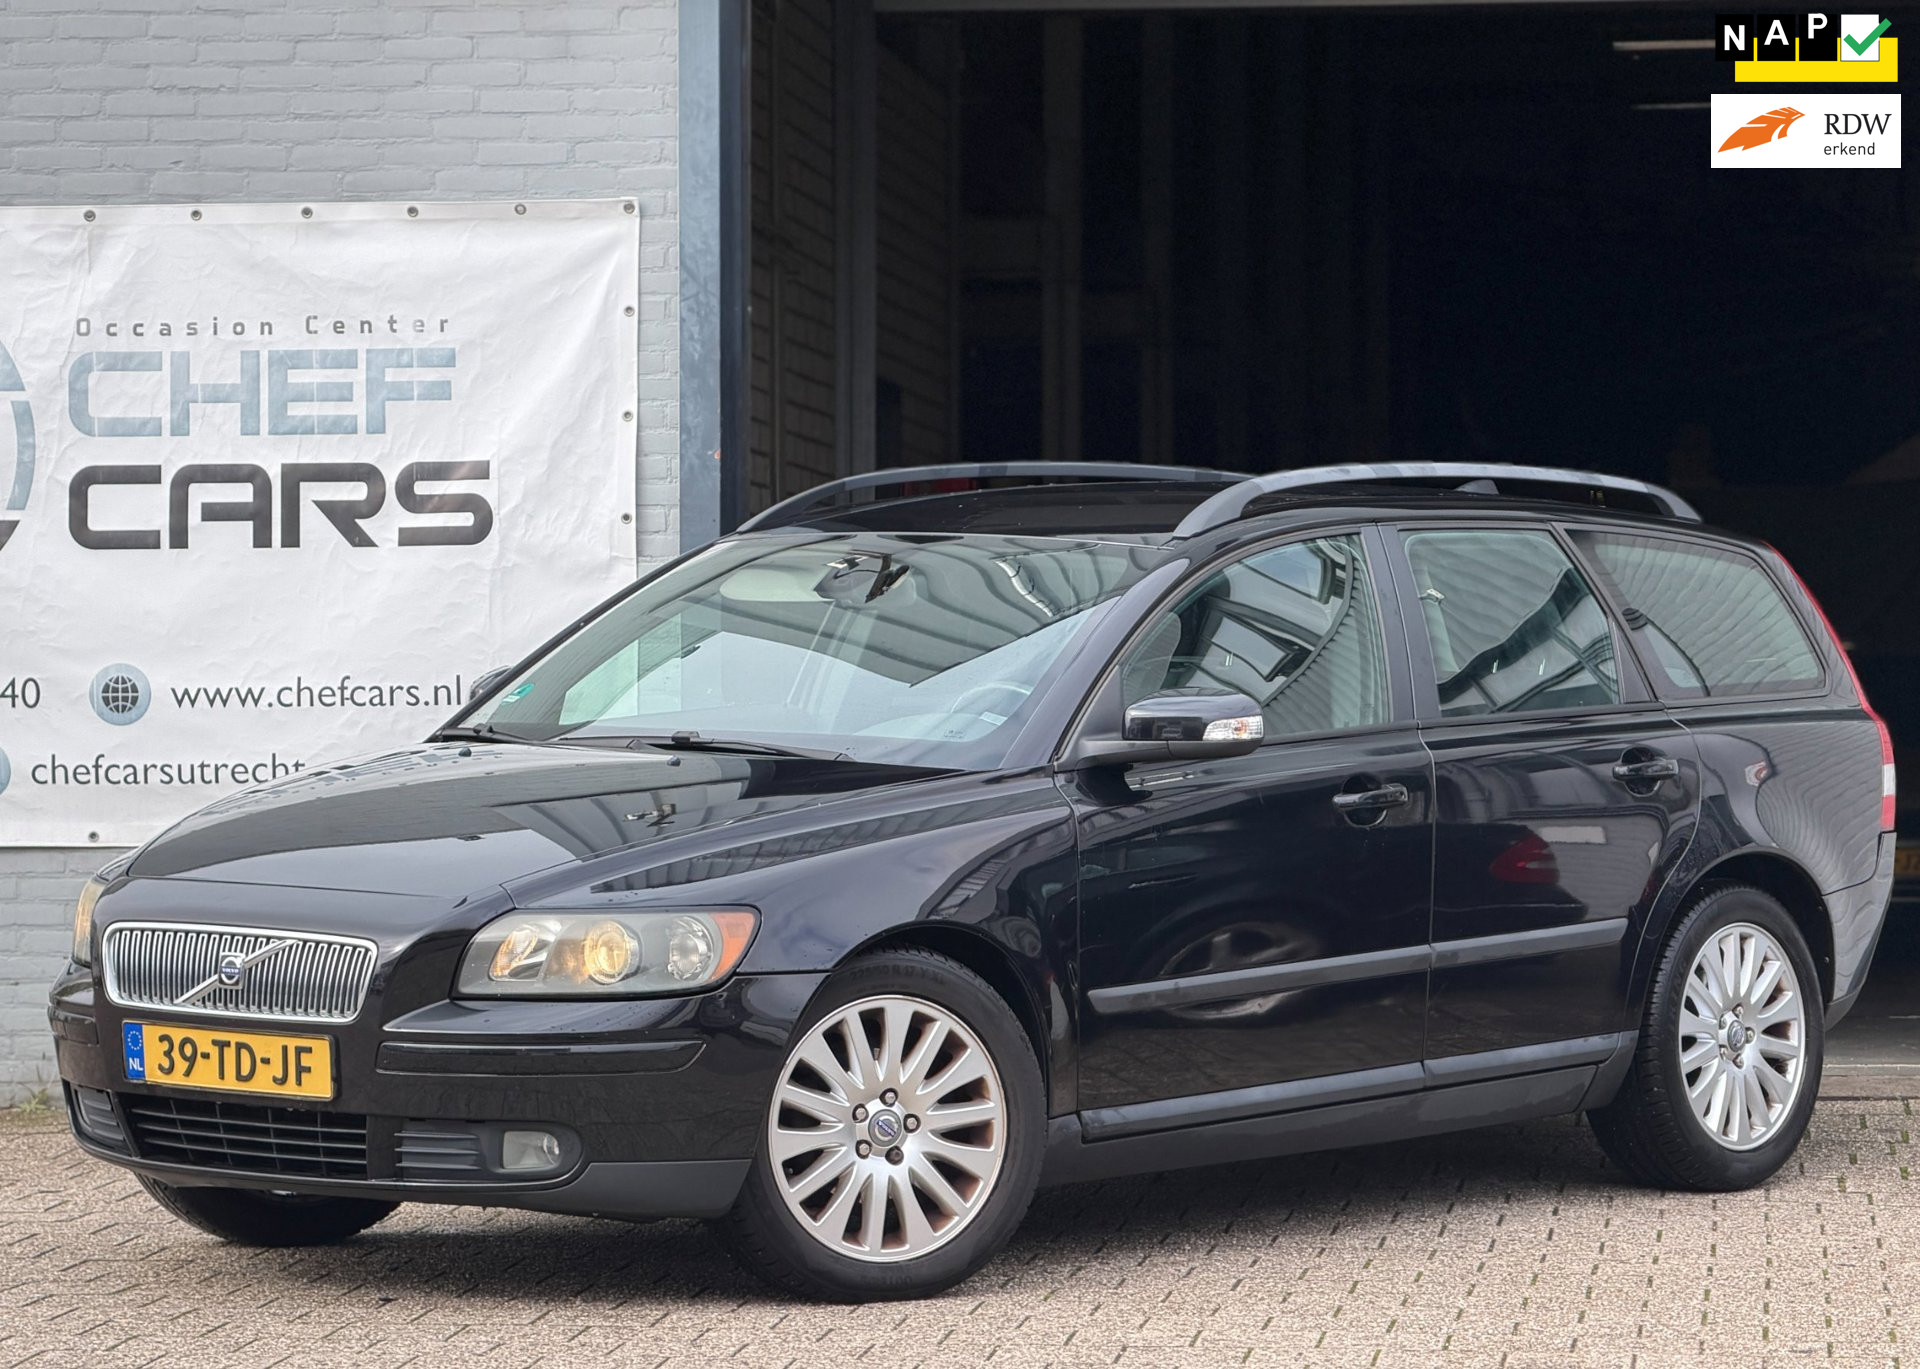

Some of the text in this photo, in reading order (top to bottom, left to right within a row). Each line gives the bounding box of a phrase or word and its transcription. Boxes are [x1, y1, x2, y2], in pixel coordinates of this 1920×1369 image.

[76, 314, 450, 337] Occasion Center
[68, 347, 457, 438] CHEF
[68, 460, 494, 550] CARS
[0, 677, 41, 709] 40
[171, 674, 462, 709] www.chefcars.nl
[129, 1057, 143, 1071] NL
[157, 1033, 313, 1087] 39-TD-JF
